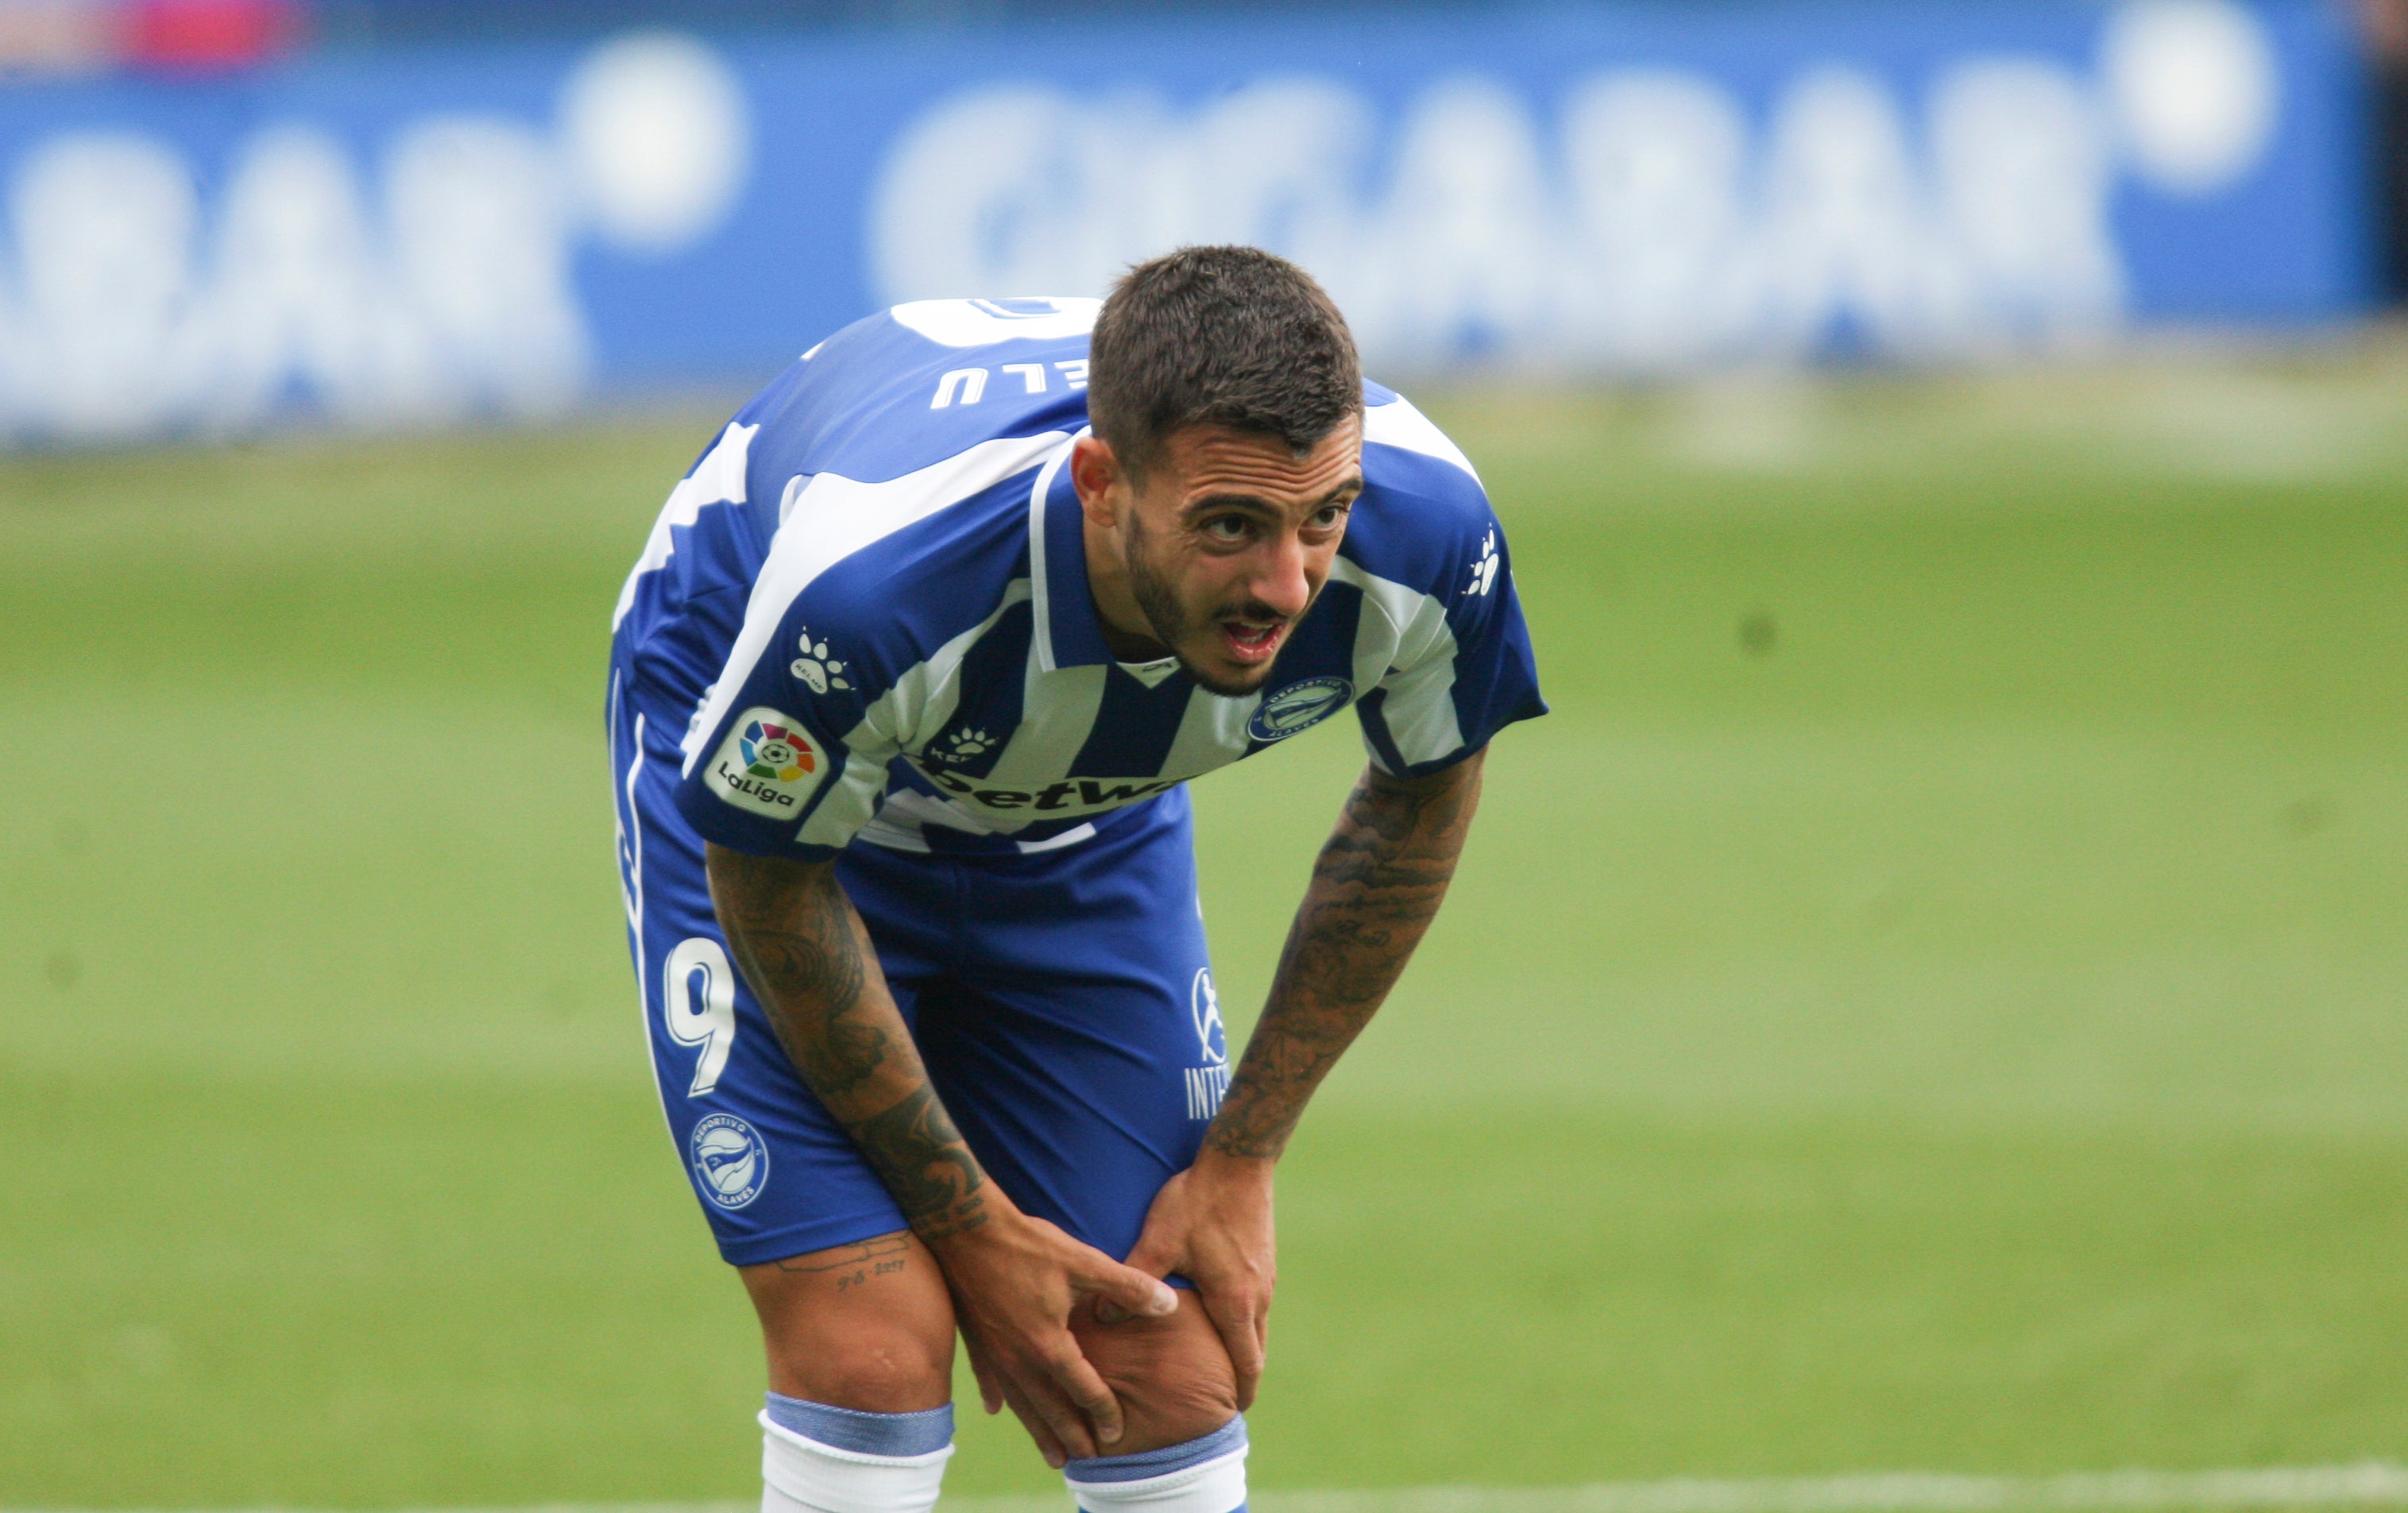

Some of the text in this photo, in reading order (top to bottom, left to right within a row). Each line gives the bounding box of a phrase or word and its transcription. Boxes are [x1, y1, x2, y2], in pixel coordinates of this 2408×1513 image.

[795, 663, 824, 691] KELME
[718, 760, 794, 807] LaLiga
[910, 755, 1185, 810] betw
[663, 936, 736, 1098] 9
[695, 1117, 745, 1143] DEPORTIVO
